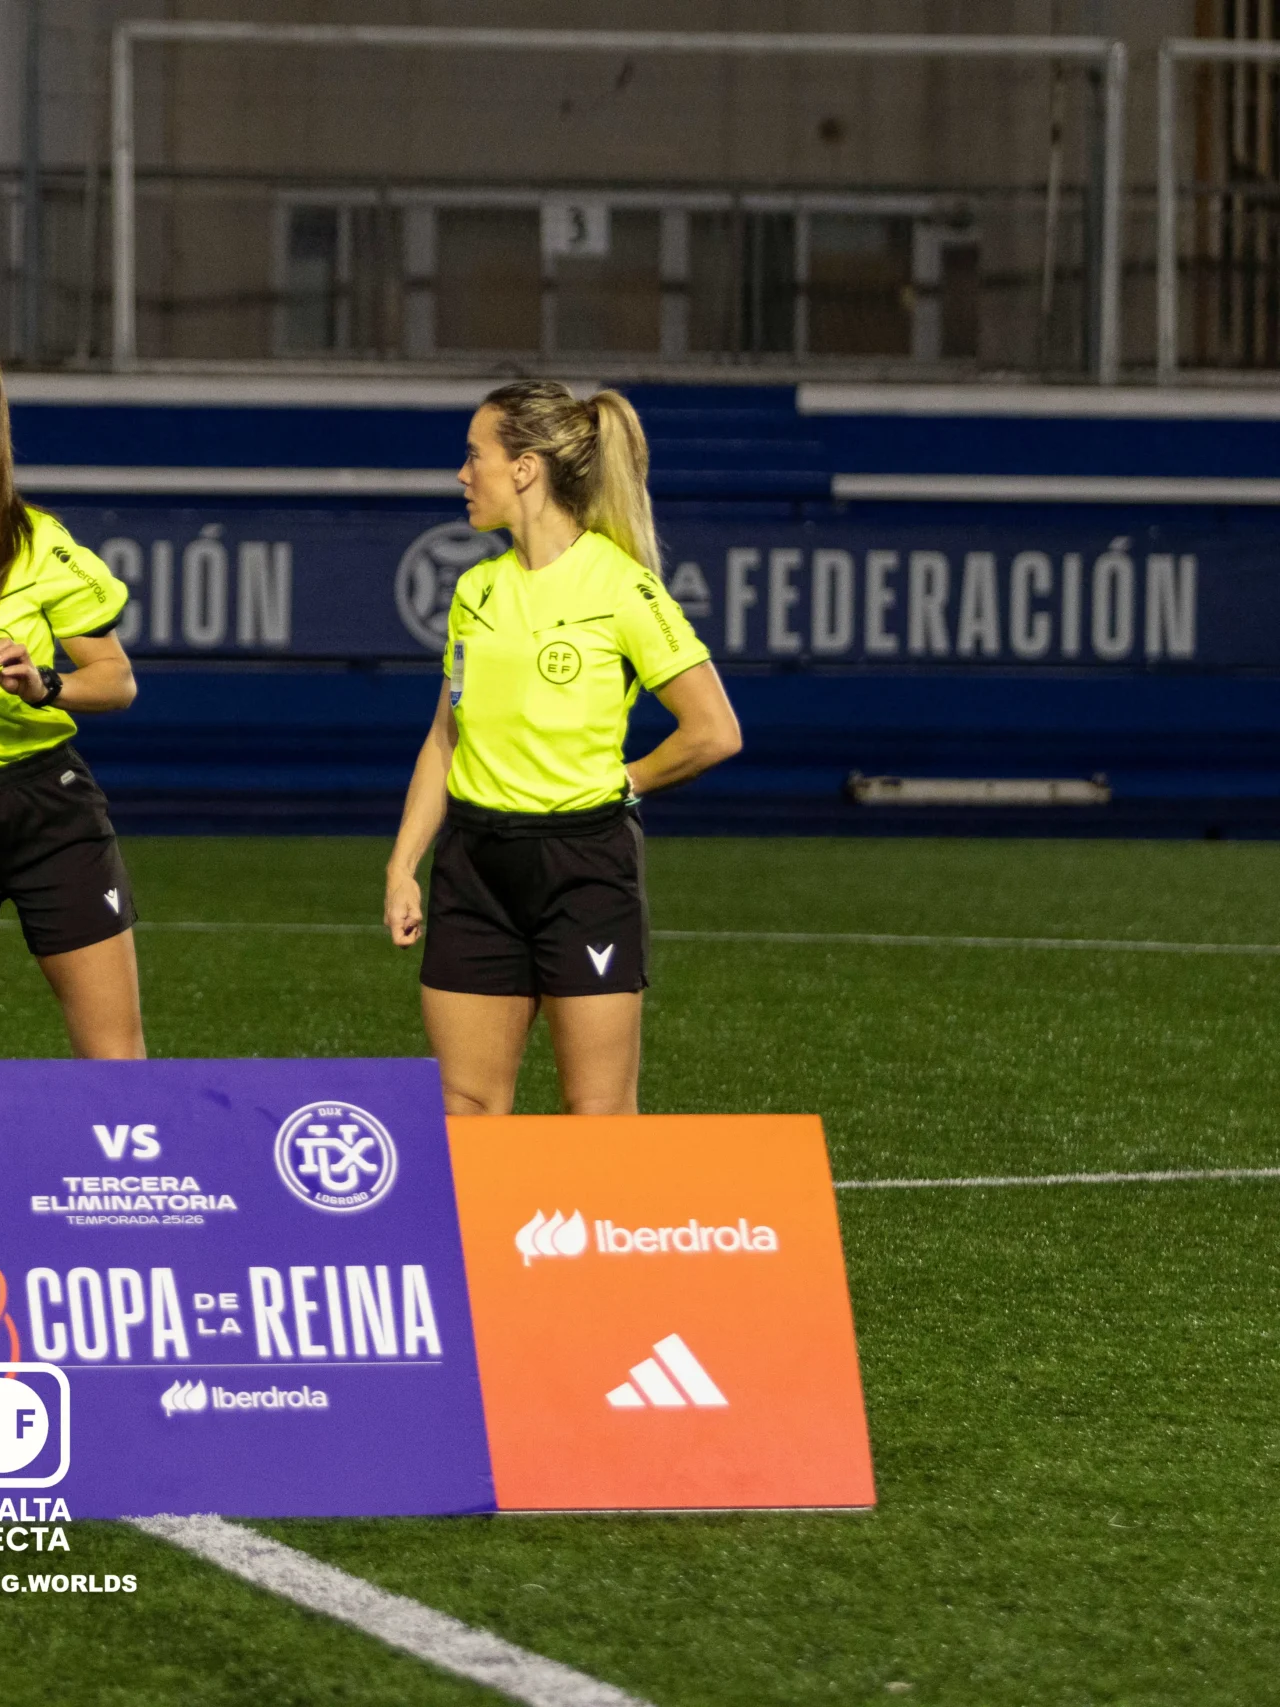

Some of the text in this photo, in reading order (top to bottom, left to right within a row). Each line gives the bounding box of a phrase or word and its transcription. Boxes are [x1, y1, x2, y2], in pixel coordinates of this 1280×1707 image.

[68, 561, 106, 604] Iberdrola
[724, 536, 1198, 660] FEDERACIÓN
[649, 601, 679, 653] Iberdrola
[318, 1107, 343, 1117] DUX
[92, 1124, 161, 1159] VS
[63, 1176, 200, 1193] TERCERA
[315, 1191, 369, 1205] LOGROÑO
[31, 1195, 238, 1212] ELIMINATORIA
[66, 1215, 205, 1225] TEMPORADA 25/26
[594, 1218, 778, 1253] Iberdrola
[26, 1264, 442, 1361] COPA DE LA REINA
[212, 1386, 328, 1409] Iberdrola
